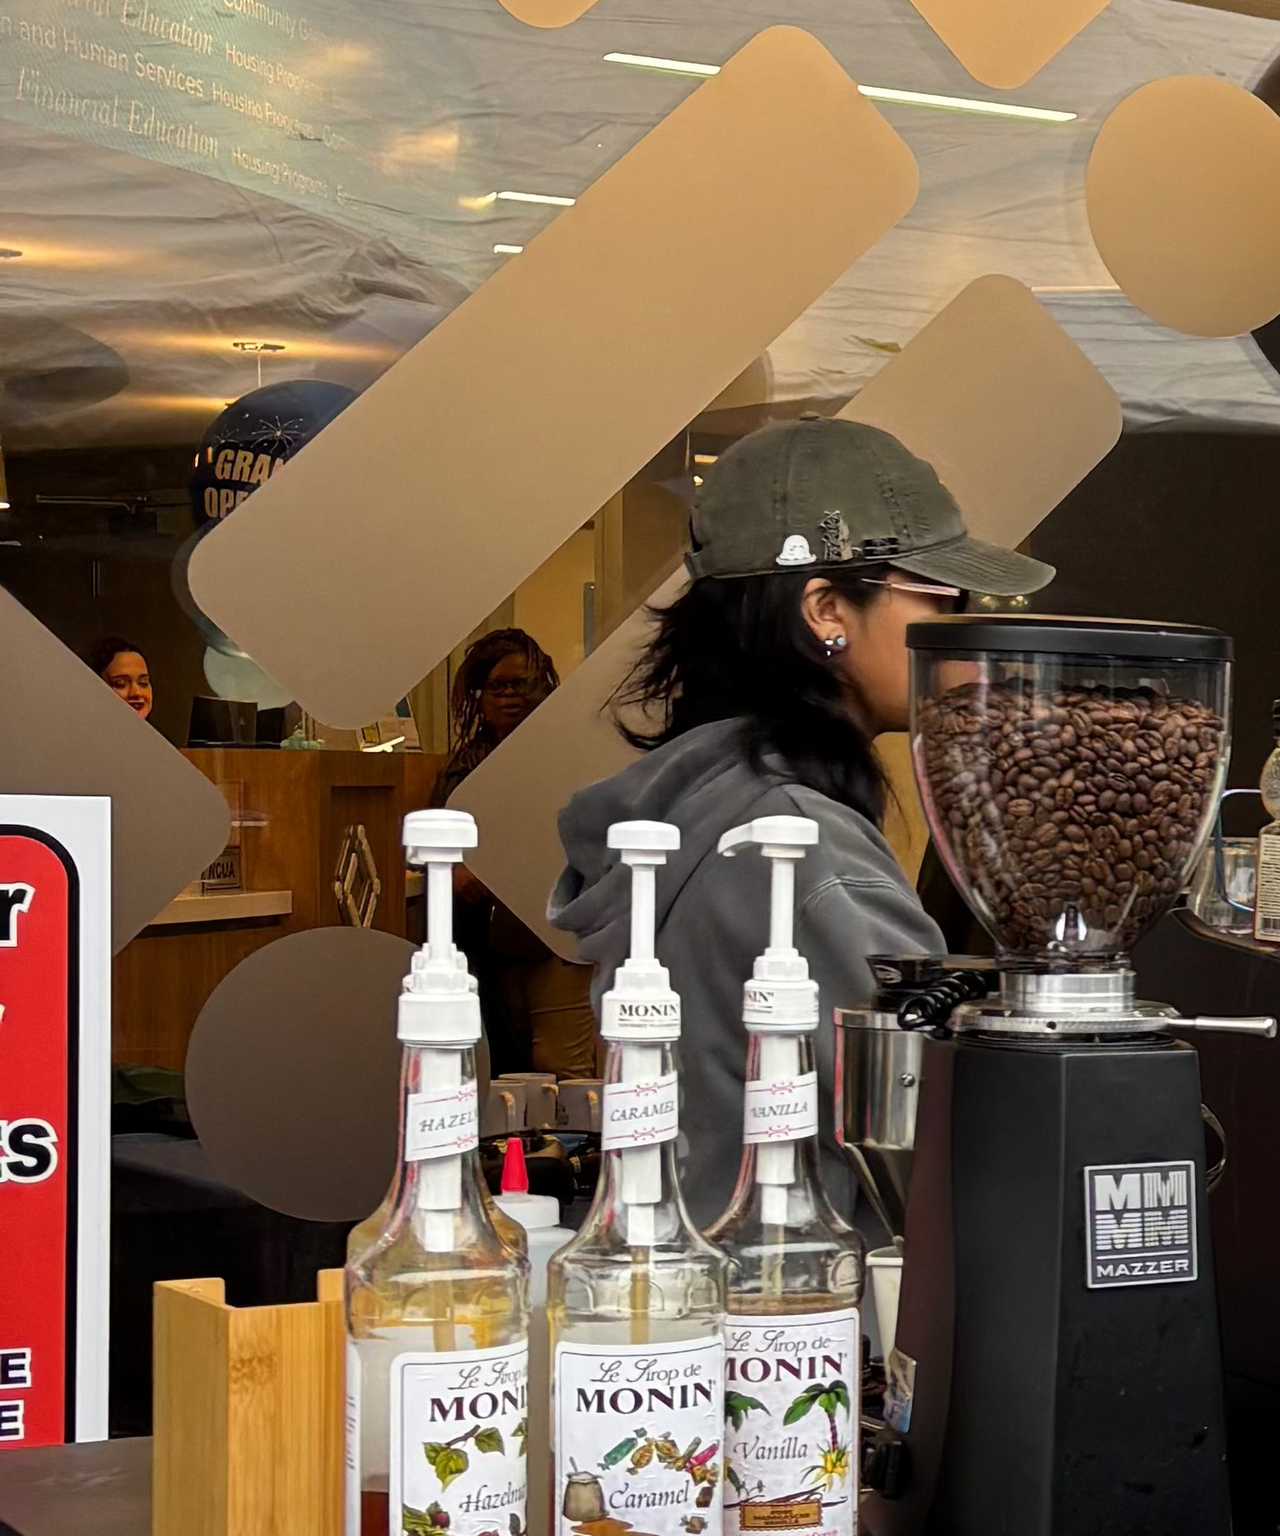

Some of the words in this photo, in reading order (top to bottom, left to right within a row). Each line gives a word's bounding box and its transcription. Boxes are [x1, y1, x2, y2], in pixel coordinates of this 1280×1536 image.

[19, 20, 56, 49] and
[63, 27, 129, 73] Human
[134, 52, 204, 98] Services
[212, 82, 263, 123] Housing
[225, 41, 274, 84] Housing
[128, 100, 218, 158] Education
[232, 146, 280, 184] Housing
[610, 1101, 675, 1122] CARAMEL
[751, 1102, 808, 1119] VANILLA
[1096, 1260, 1189, 1278] MAZZER
[725, 1331, 750, 1352] Le
[755, 1330, 807, 1355] Sirop
[811, 1336, 842, 1351] de
[448, 1365, 481, 1390] Le
[590, 1360, 622, 1383] Le
[626, 1359, 679, 1385] Sirop
[683, 1363, 702, 1378] de
[576, 1380, 714, 1414] MONIN
[733, 1436, 808, 1460] Vanilla
[609, 1480, 689, 1509] Caramel
